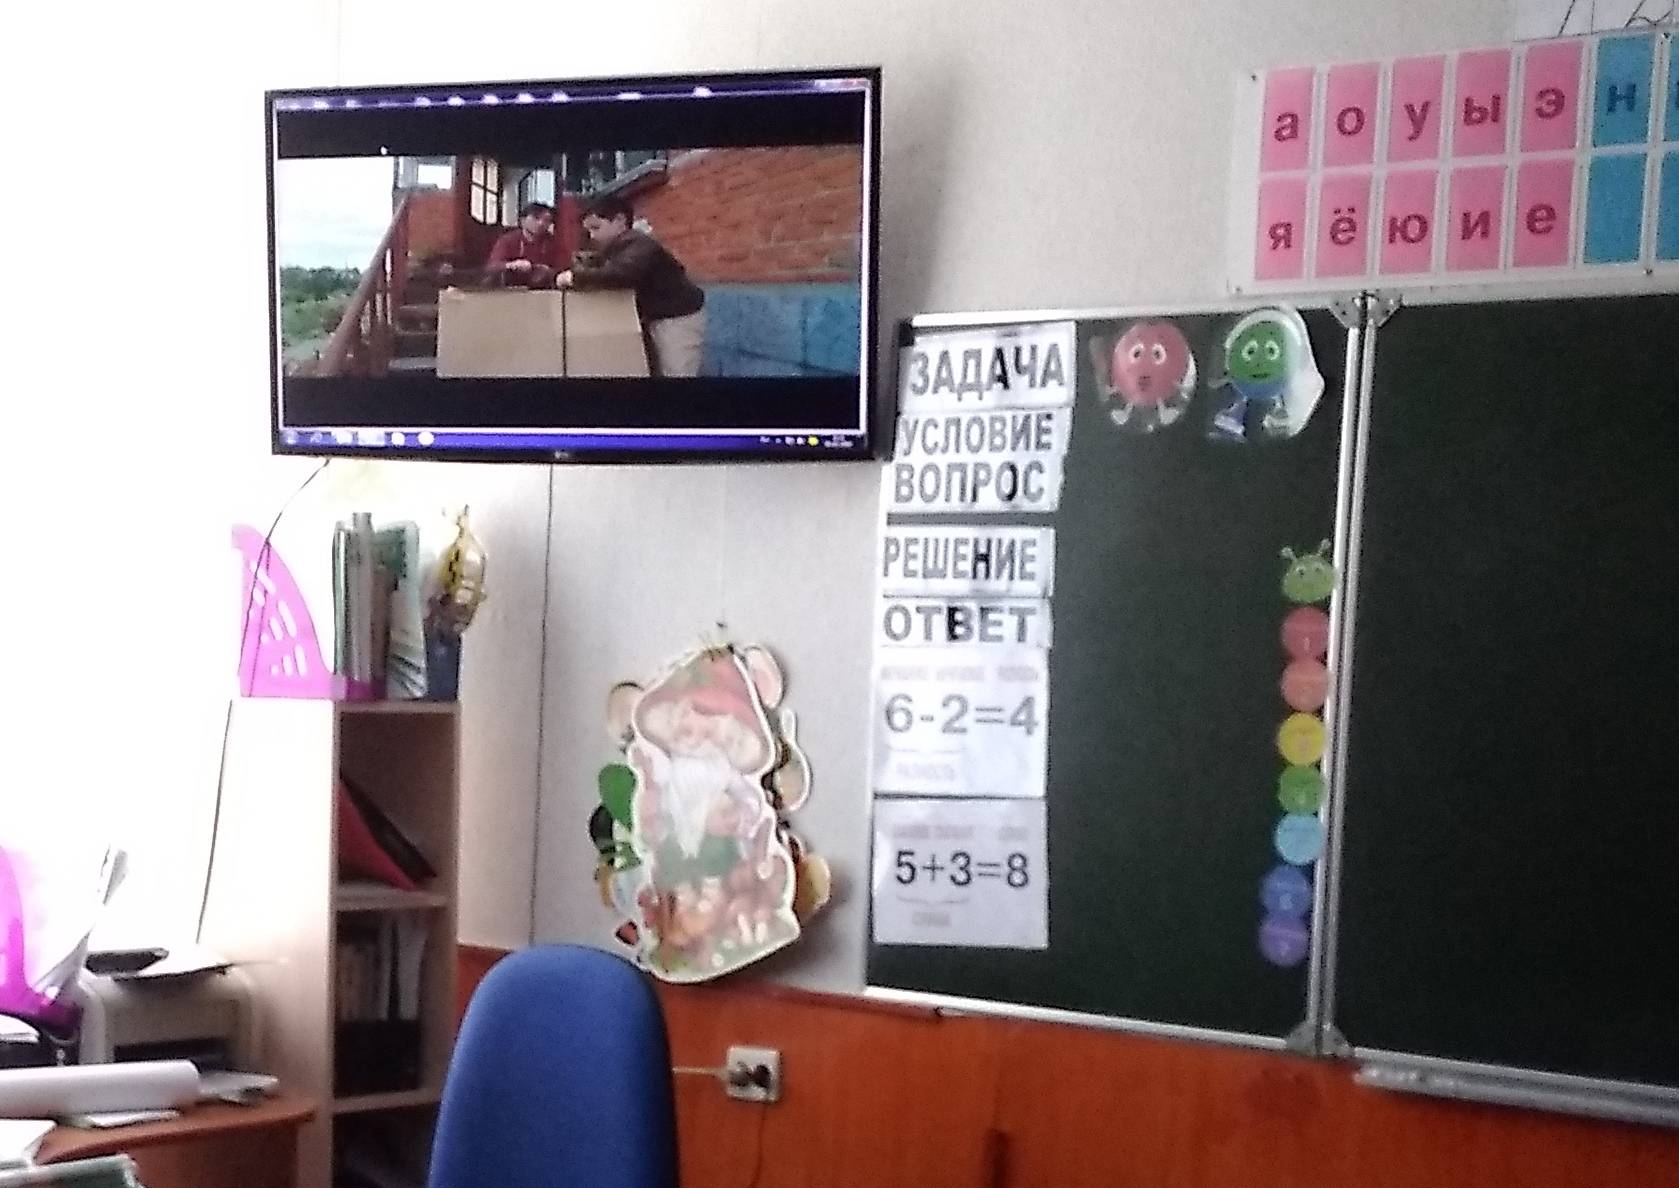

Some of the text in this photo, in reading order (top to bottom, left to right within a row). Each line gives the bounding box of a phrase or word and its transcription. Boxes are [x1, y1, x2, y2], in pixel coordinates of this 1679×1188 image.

[1273, 111, 1300, 142] а
[1336, 105, 1366, 137] о
[1403, 99, 1432, 142] у
[1462, 93, 1501, 127] ы
[1534, 86, 1566, 120] э
[1268, 202, 1558, 251] я ё ю и е
[910, 342, 1066, 402] ЗАДАЧА
[899, 412, 1054, 456] УСЛОВИЕ
[893, 459, 1046, 504] ВОПРОС
[882, 535, 1038, 582] РЕШЕНИЕ
[882, 602, 1038, 644] ОТВЕТ
